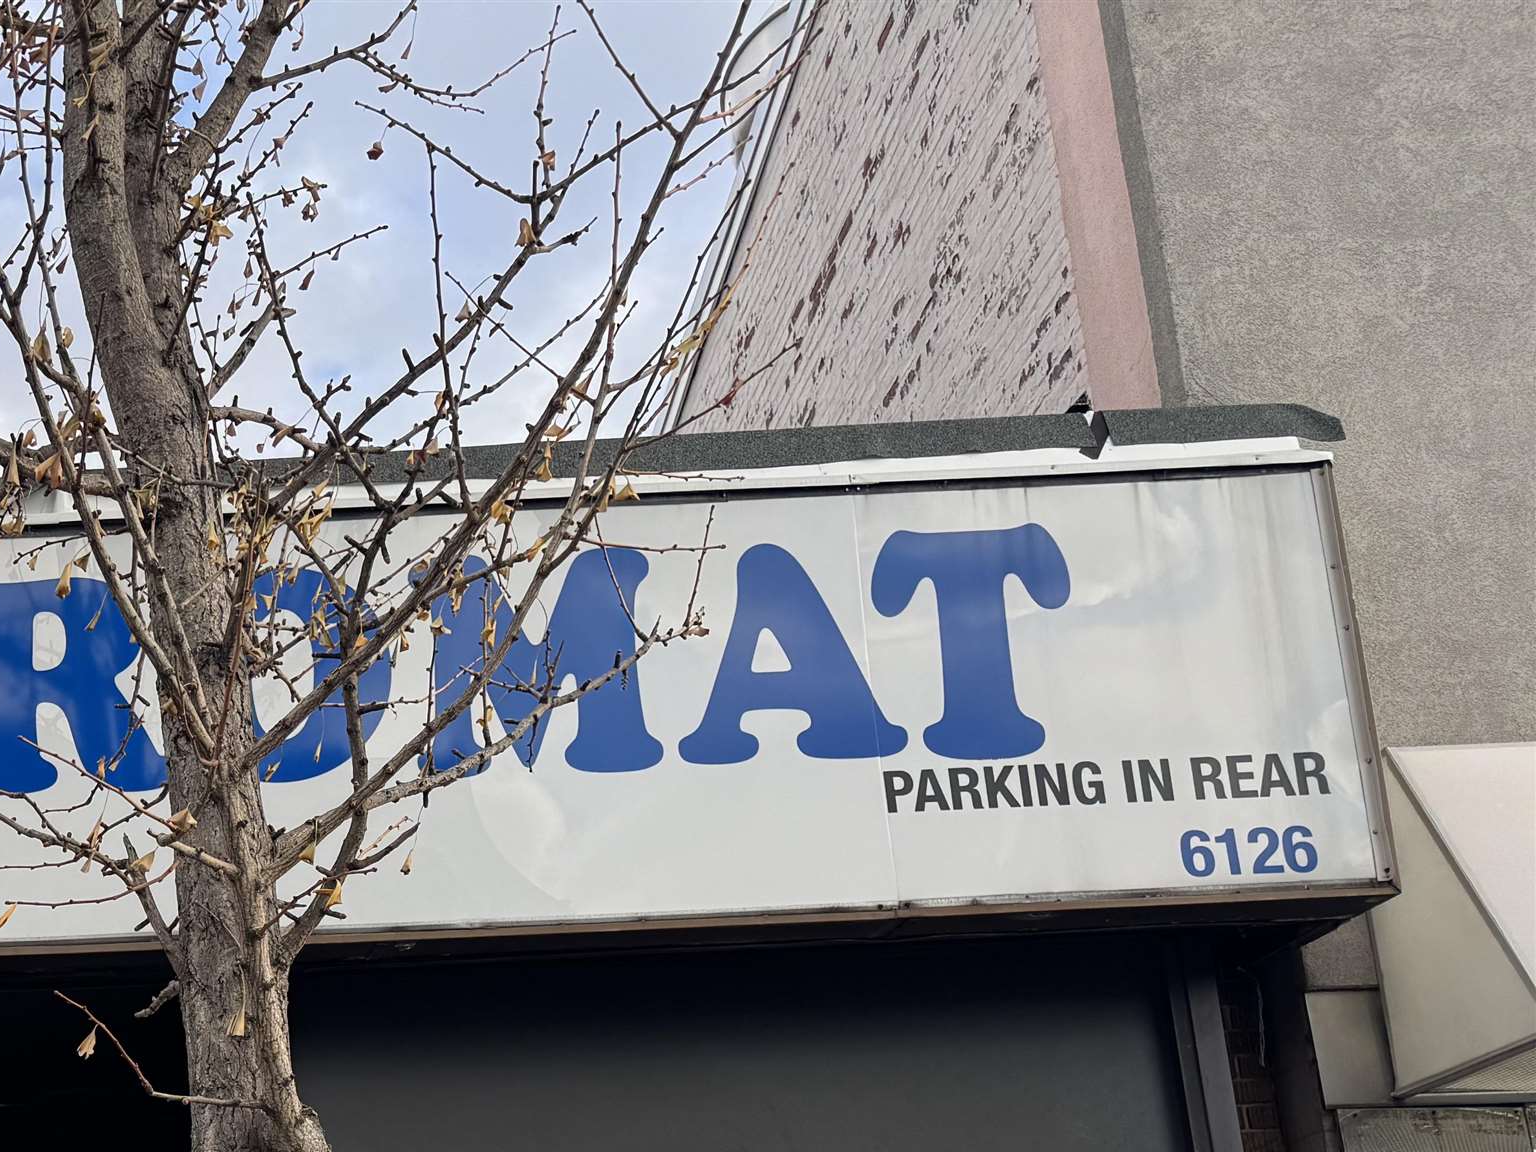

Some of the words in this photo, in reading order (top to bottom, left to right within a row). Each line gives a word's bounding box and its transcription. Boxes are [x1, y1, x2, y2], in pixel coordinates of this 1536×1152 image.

[882, 760, 1107, 814] PARKING
[1121, 759, 1175, 804] IN
[1189, 751, 1332, 802] REAR
[1179, 826, 1319, 877] 6126
